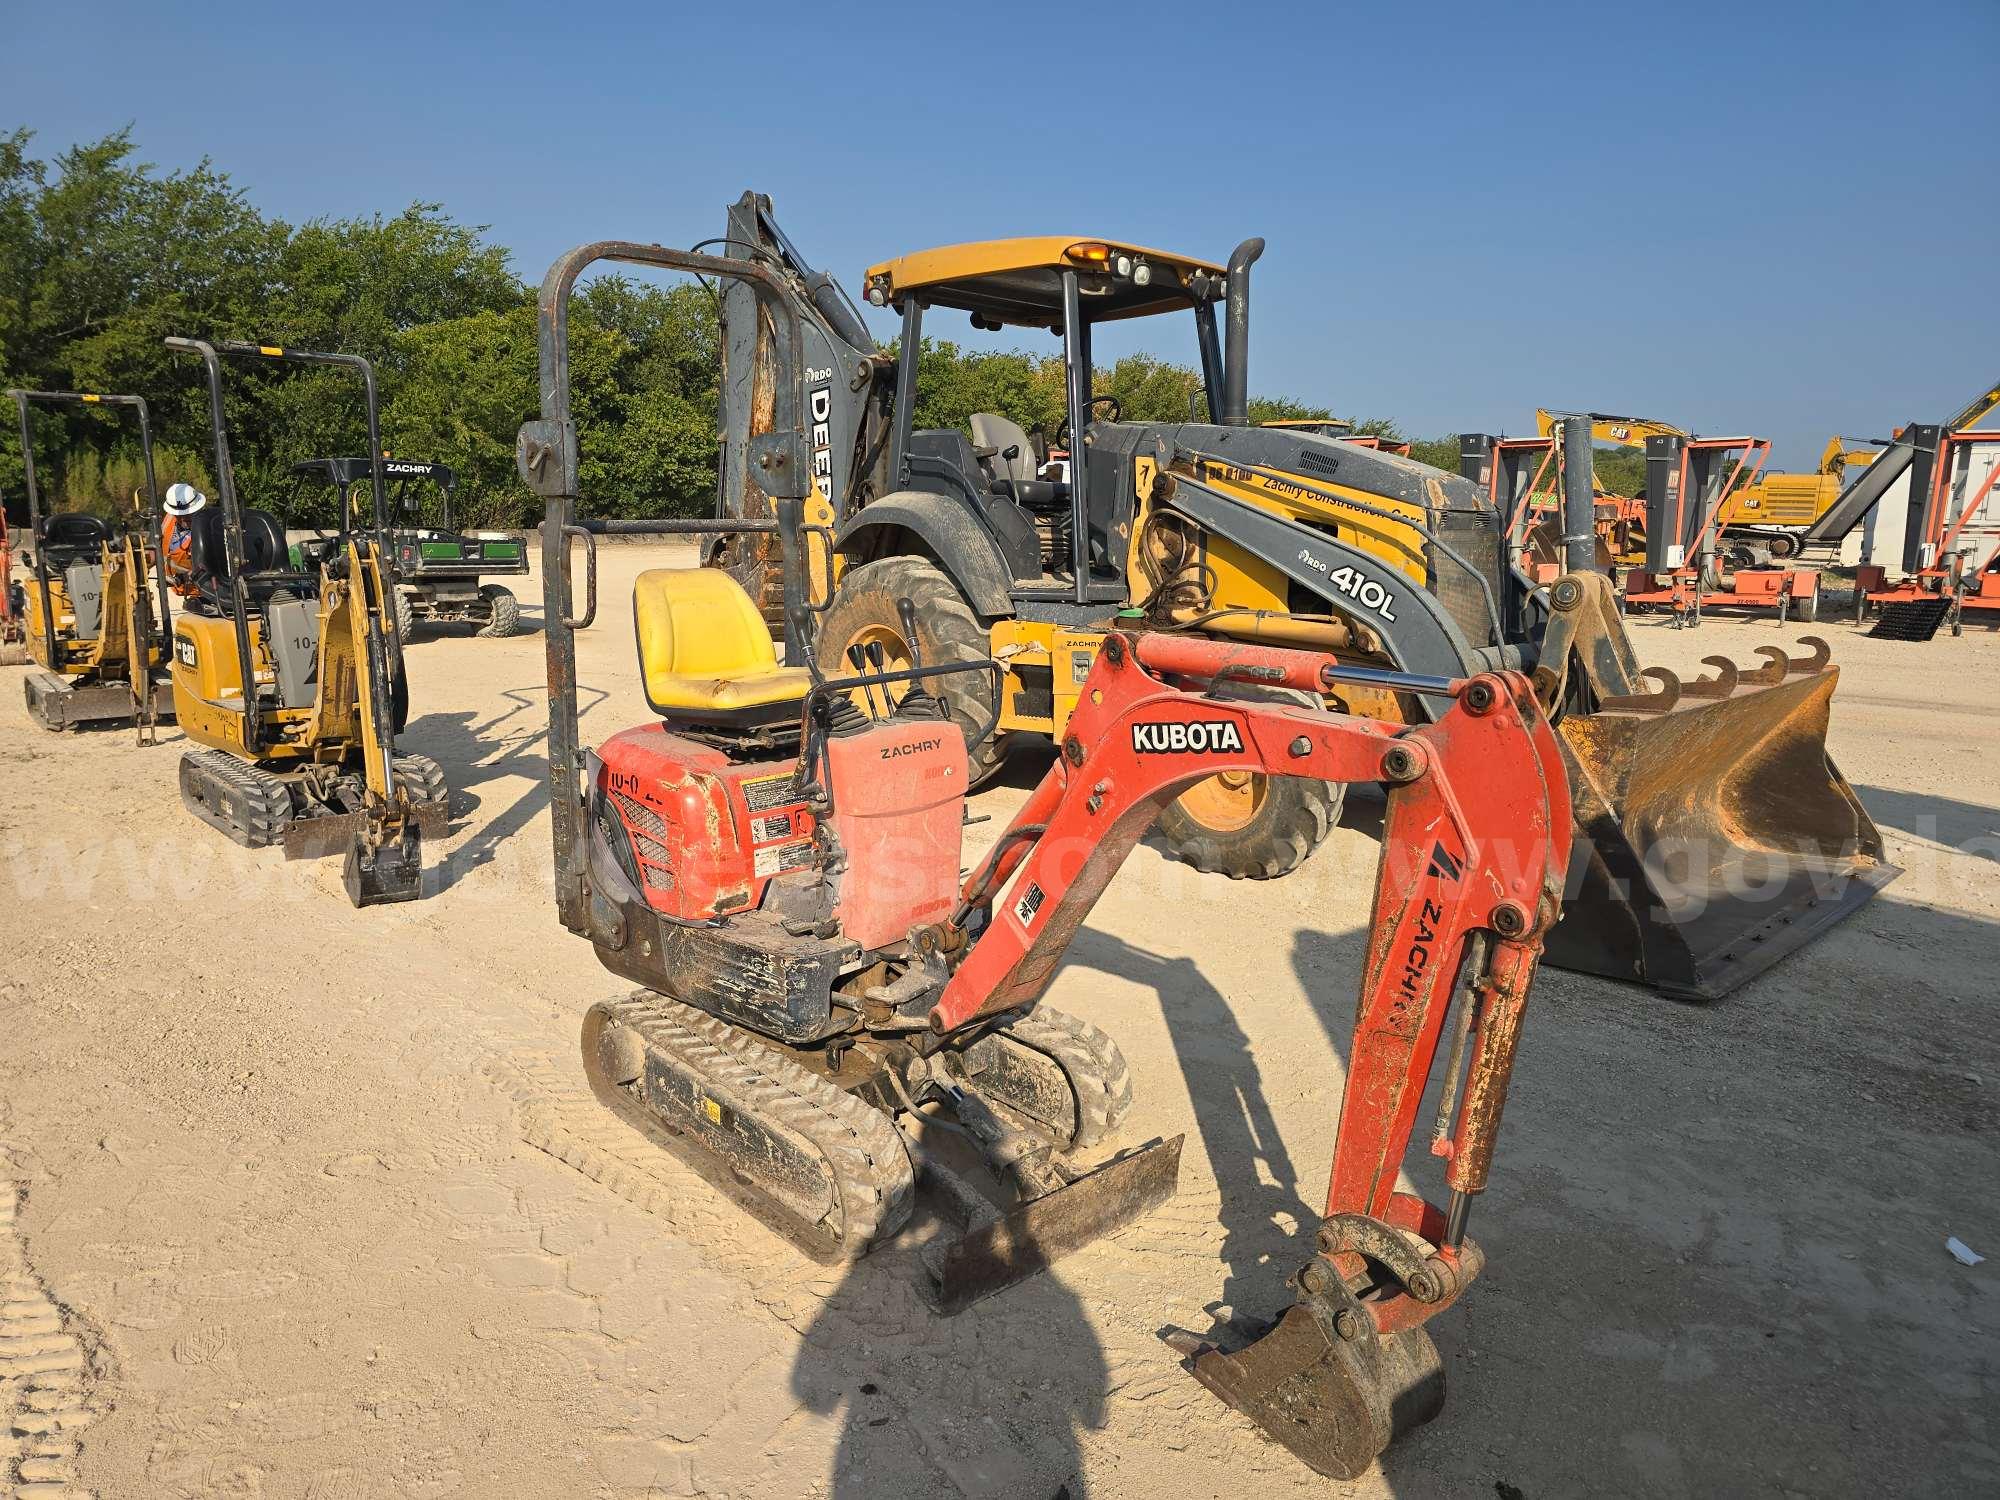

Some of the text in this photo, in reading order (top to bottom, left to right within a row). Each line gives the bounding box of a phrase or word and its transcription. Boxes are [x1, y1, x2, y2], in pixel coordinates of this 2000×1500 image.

[1610, 426, 1629, 440] CAT
[811, 387, 833, 504] DEER
[386, 463, 433, 474] ZACHRY
[1263, 477, 1303, 499] Zachry
[1743, 499, 1760, 508] CAT
[1329, 565, 1397, 624] 410L
[182, 641, 196, 666] CAT
[1066, 640, 1103, 648] ZACHRY
[1133, 722, 1242, 751] KUBOTA
[880, 738, 942, 760] ZACHRY
